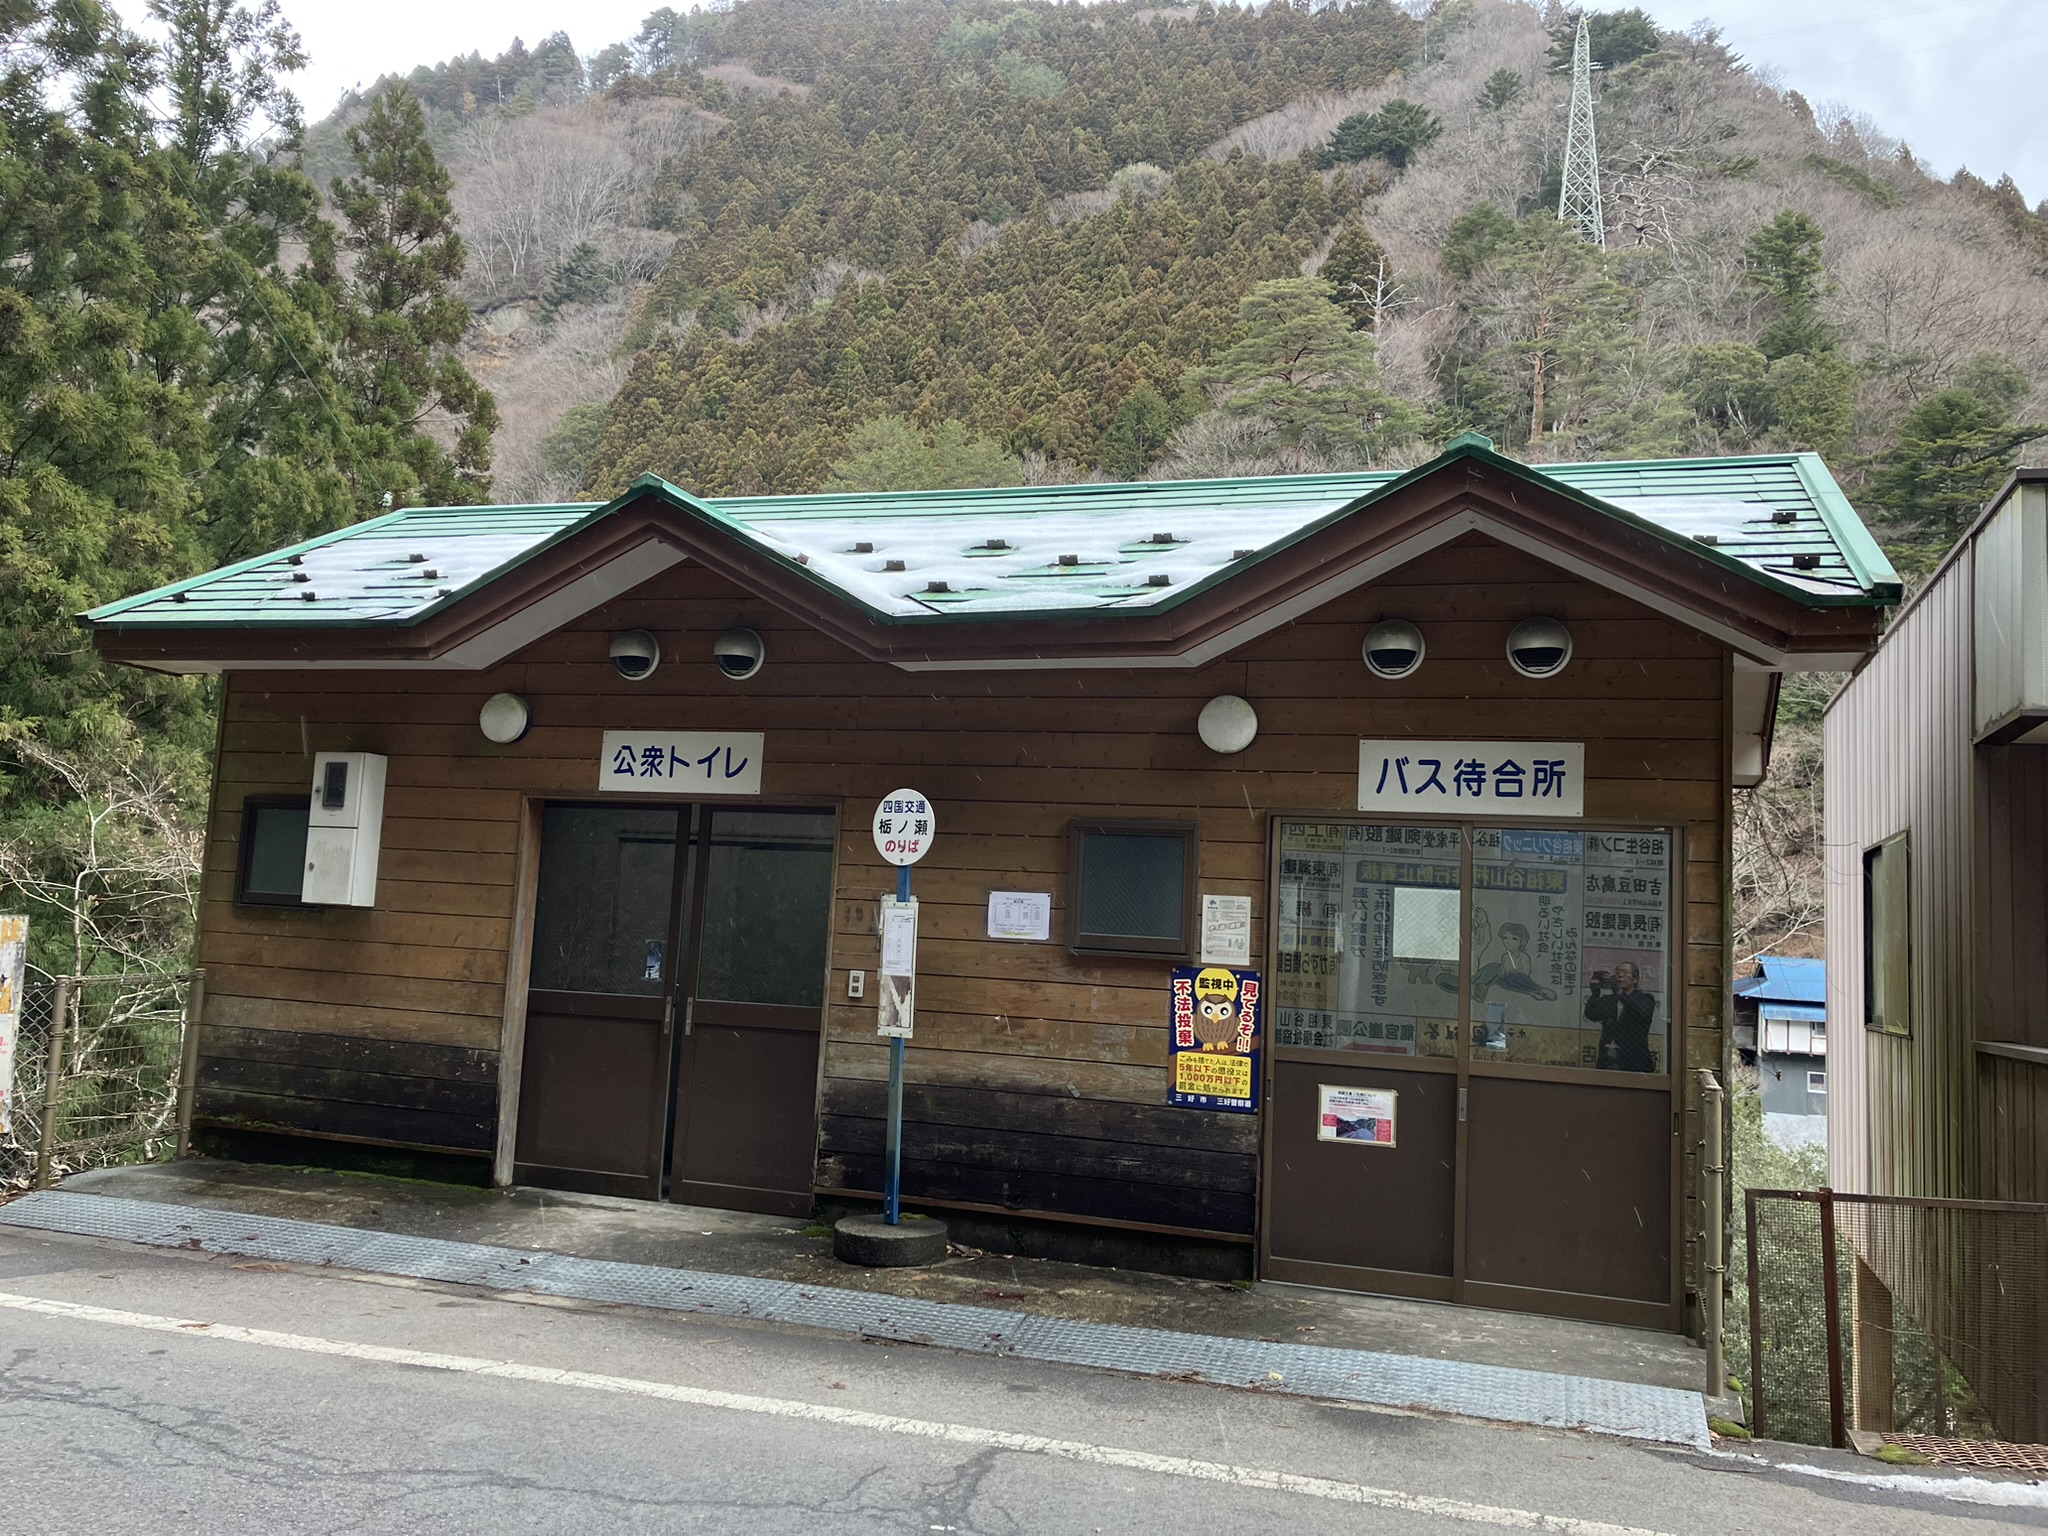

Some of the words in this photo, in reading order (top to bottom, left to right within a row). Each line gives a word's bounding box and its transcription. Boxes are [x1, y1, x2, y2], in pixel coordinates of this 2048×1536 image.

[613, 745, 748, 778] 公衆トイレ
[1376, 756, 1566, 798] バス待合所
[883, 800, 926, 814] 四国交通
[879, 819, 928, 836] 栃ノ瀬
[885, 840, 920, 853] のりば
[1199, 977, 1234, 991] 監視中
[1175, 979, 1193, 1045] 不法投棄
